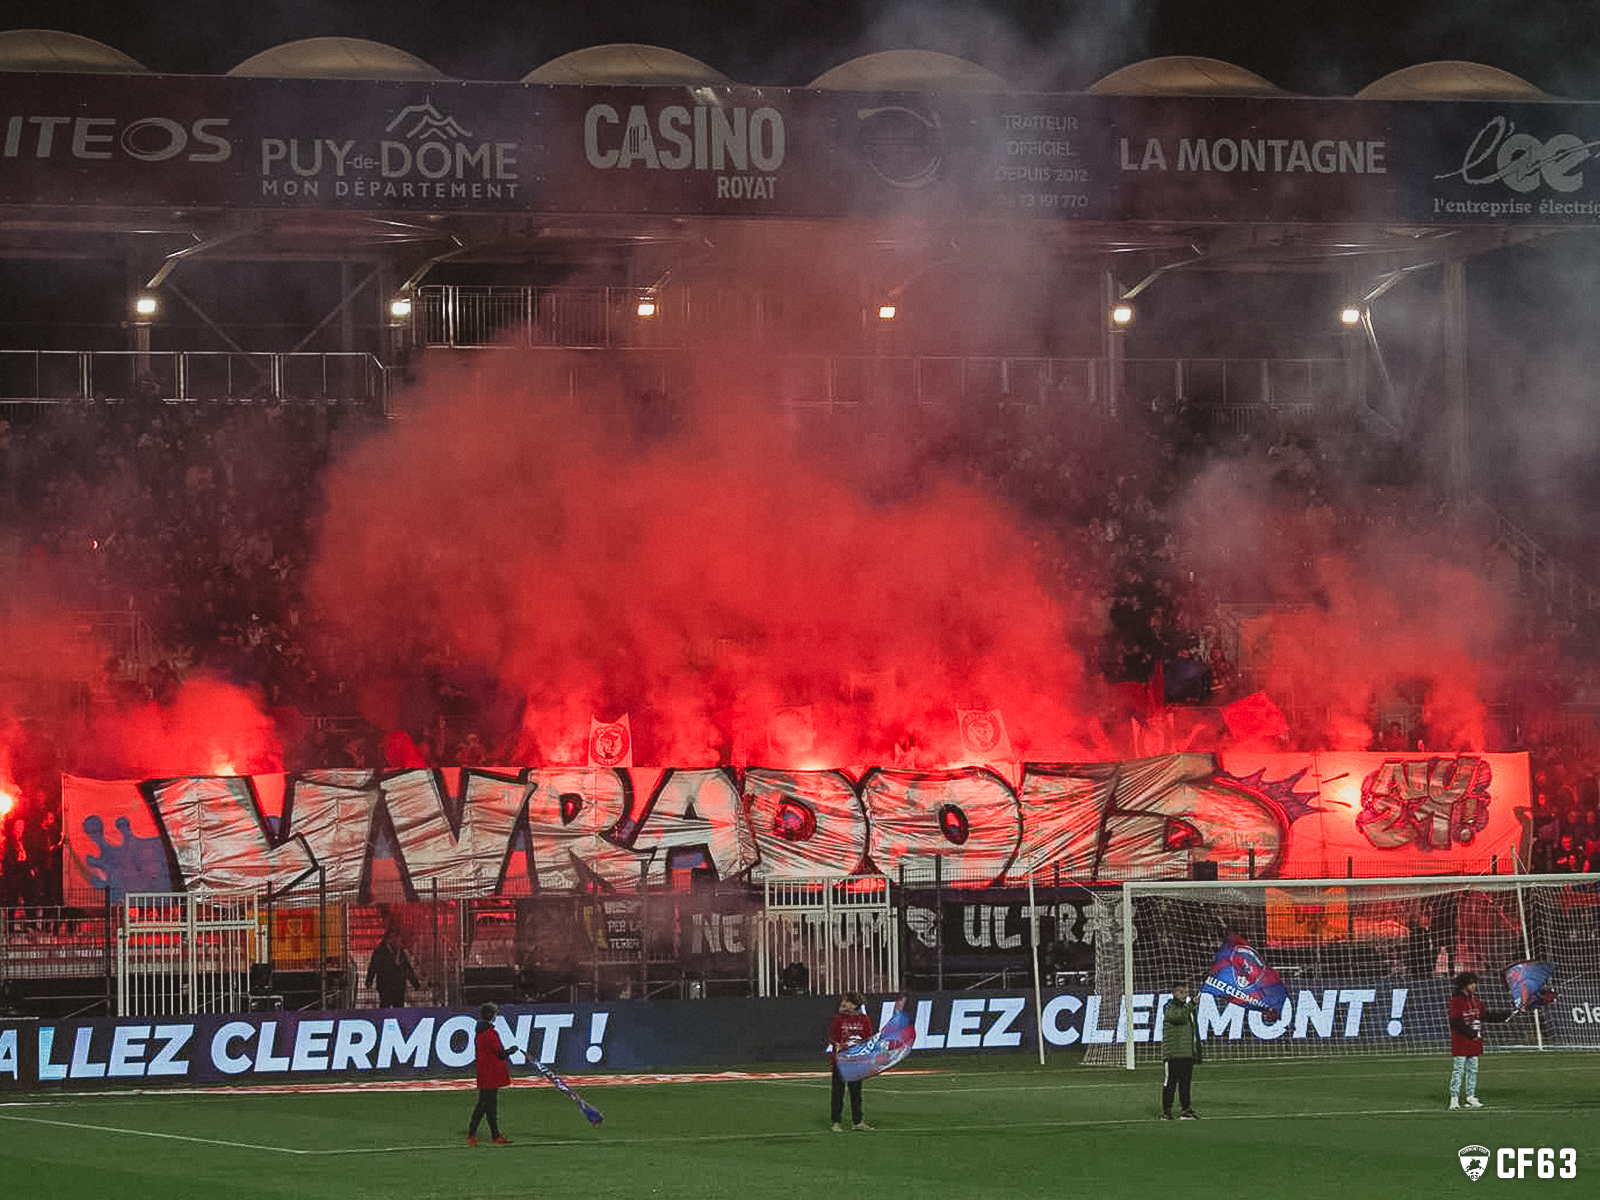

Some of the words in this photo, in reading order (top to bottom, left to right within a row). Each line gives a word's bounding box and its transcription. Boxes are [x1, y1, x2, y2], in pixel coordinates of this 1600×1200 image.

[1003, 115, 1079, 131] TRAITEUR
[584, 104, 786, 171] CASINO
[1005, 140, 1073, 156] OFFICIEL
[1119, 138, 1167, 171] LA
[1178, 138, 1387, 174] MONTAGNE
[262, 180, 320, 197] MON
[335, 178, 519, 200] DÉPARTEMENT
[717, 176, 777, 200] ROYAT
[1433, 198, 1533, 217] l'entreprise
[210, 1013, 575, 1074] CLERMONT
